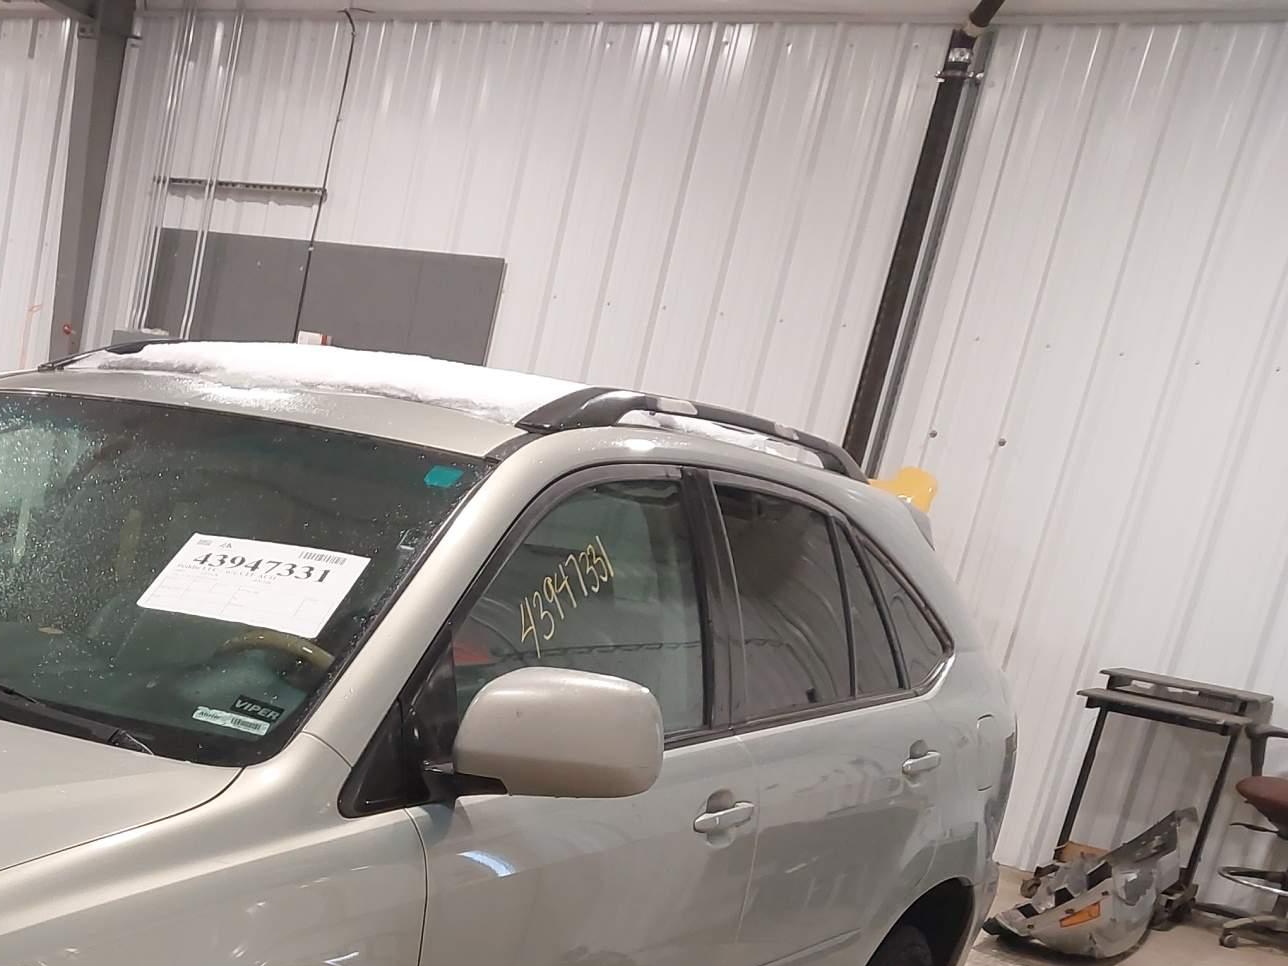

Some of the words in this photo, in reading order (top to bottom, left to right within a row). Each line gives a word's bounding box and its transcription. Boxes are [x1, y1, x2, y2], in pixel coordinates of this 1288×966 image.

[192, 551, 331, 584] 43947331
[520, 535, 614, 659] 43947331
[235, 699, 281, 720] VIPER
